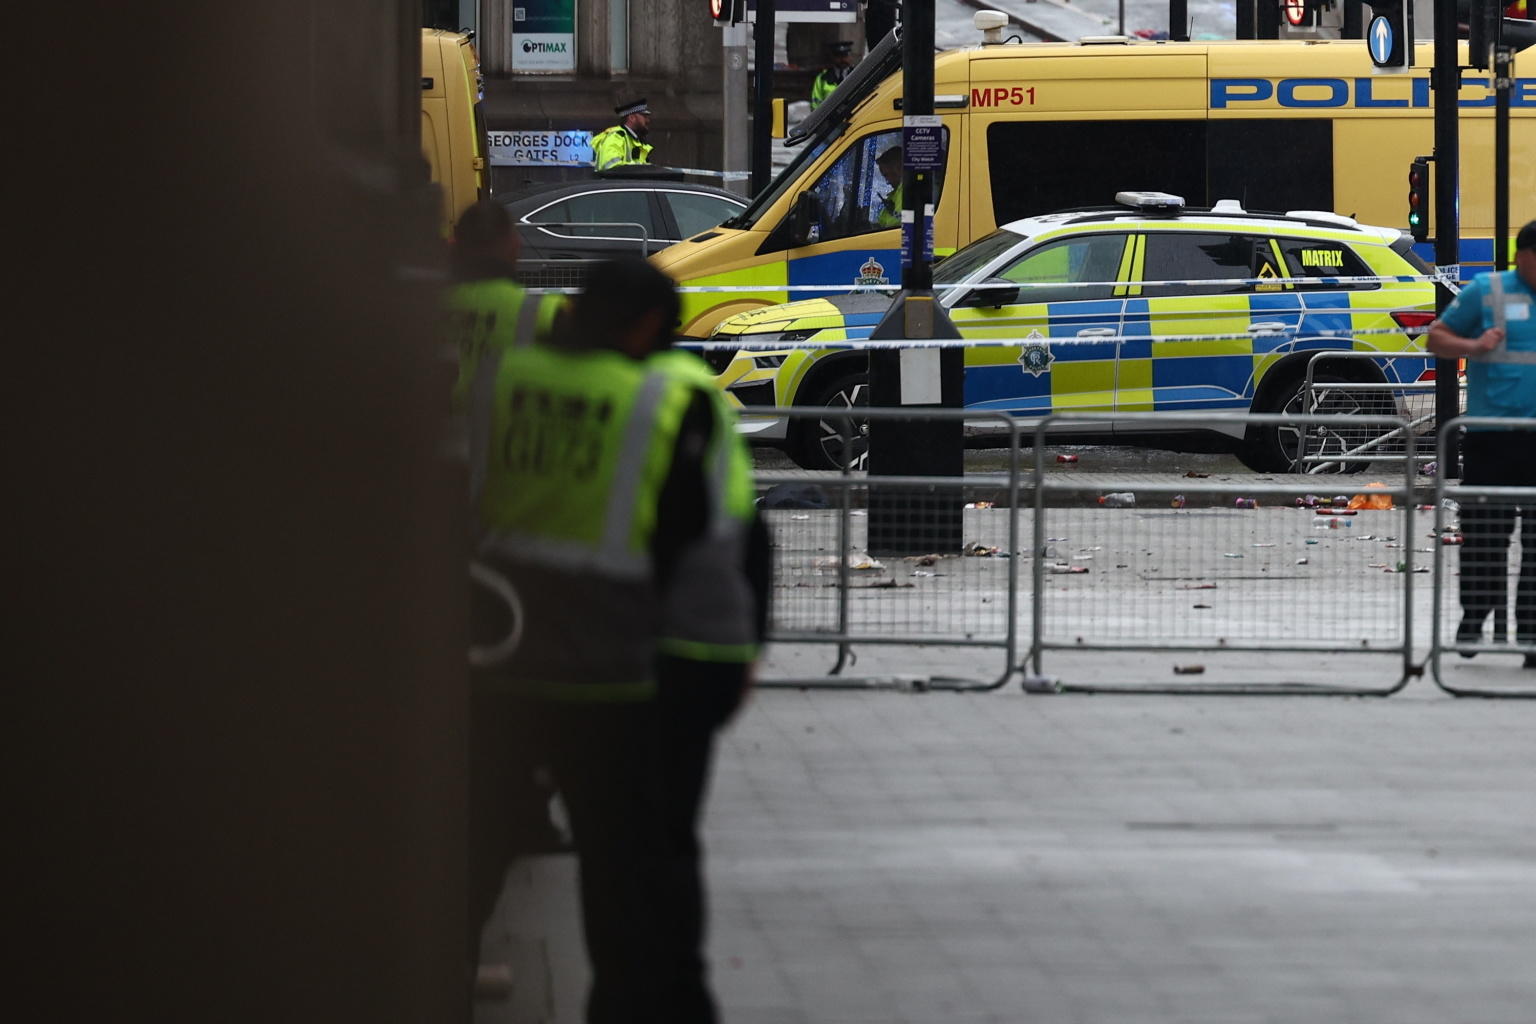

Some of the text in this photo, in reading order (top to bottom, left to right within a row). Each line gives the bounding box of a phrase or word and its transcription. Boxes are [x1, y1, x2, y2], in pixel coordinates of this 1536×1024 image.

[522, 40, 567, 53] OPTIMAX
[971, 86, 1036, 107] MP51
[554, 135, 589, 147] DOCK
[514, 149, 559, 162] GATES
[1302, 249, 1344, 267] MATRIX
